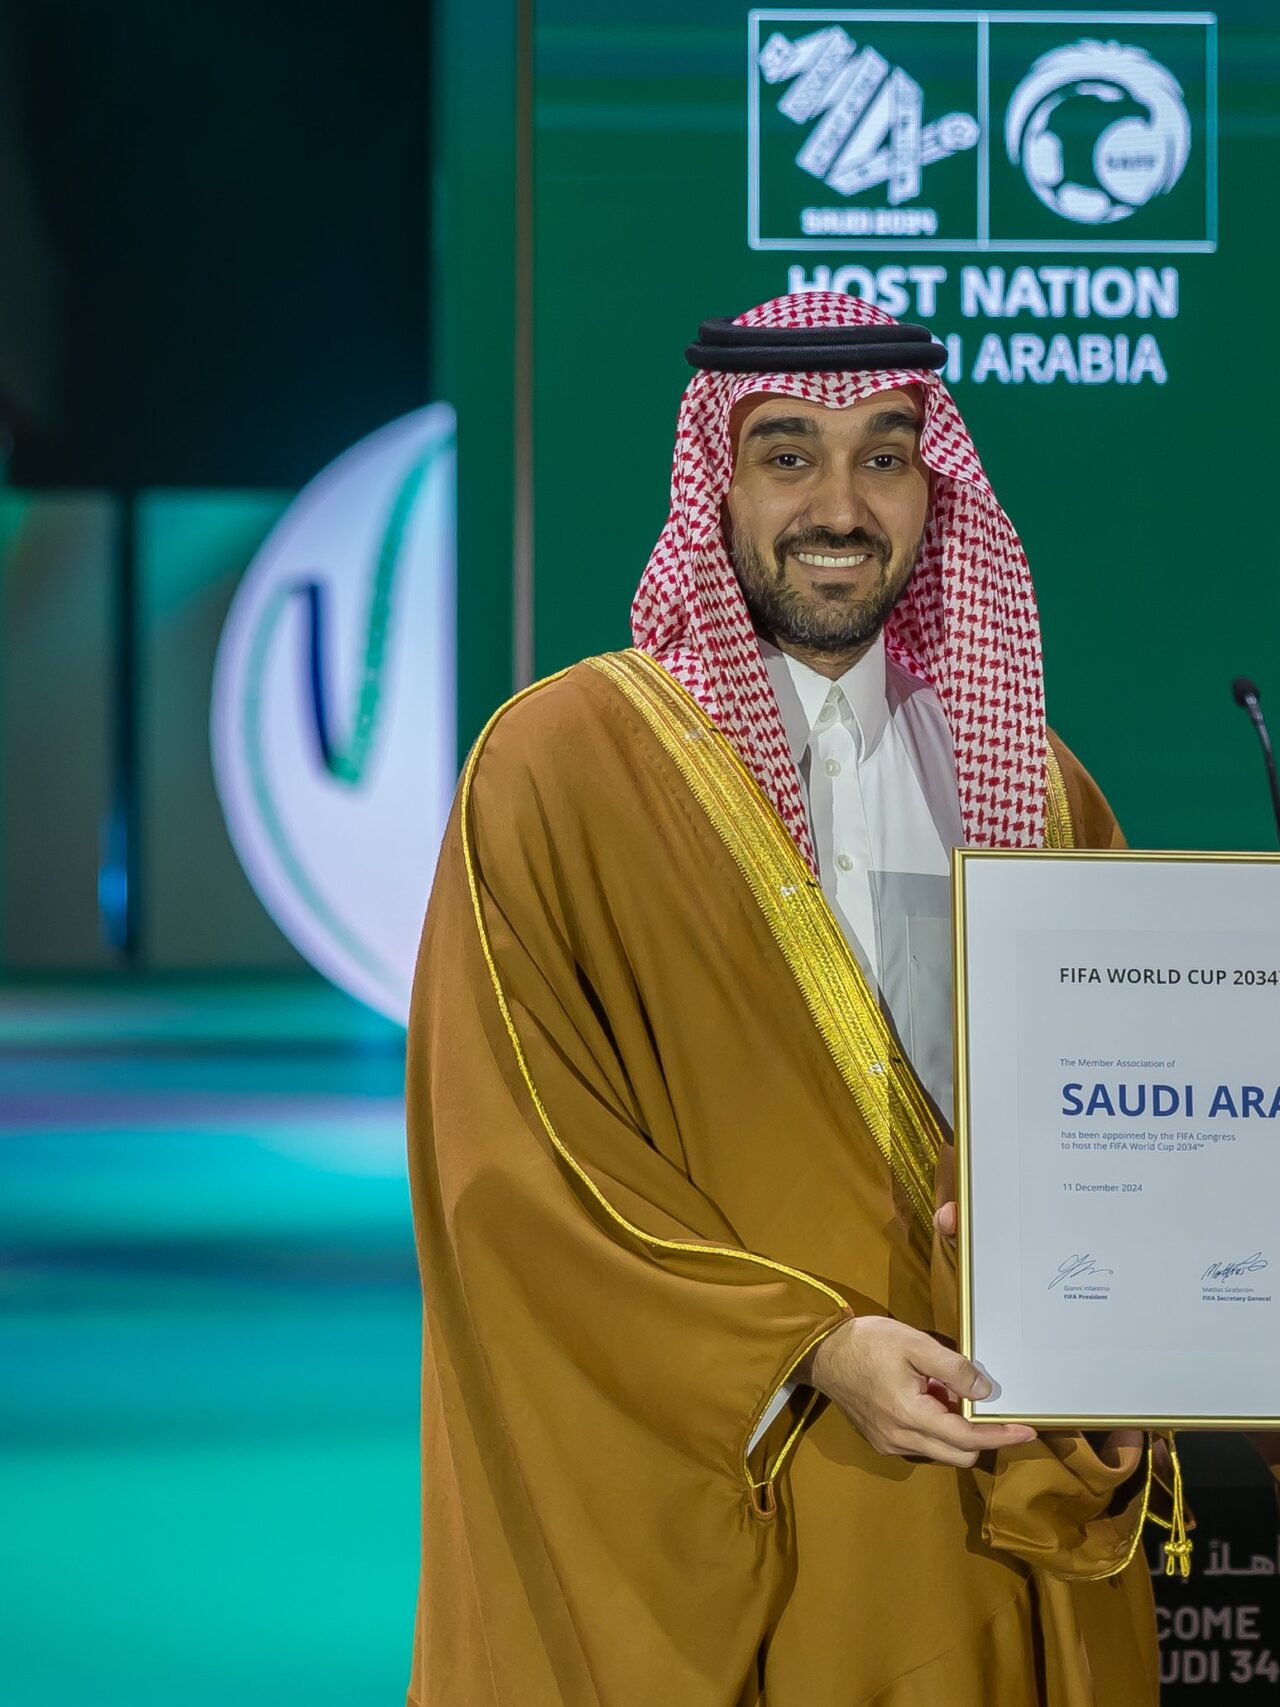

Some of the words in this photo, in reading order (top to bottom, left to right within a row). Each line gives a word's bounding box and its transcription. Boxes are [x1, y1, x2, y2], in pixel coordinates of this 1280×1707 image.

[961, 266, 1179, 318] NATION
[972, 333, 1168, 385] ARABIA
[1060, 967, 1102, 984] FIFA
[1106, 968, 1181, 985] WORLD
[1187, 969, 1227, 985] CUP
[1059, 1058, 1076, 1067] The
[1078, 1058, 1114, 1068] Member
[1116, 1059, 1165, 1068] Association
[1166, 1059, 1176, 1068] of
[1062, 1083, 1194, 1117] SAUDI
[1060, 1130, 1077, 1139] has
[1078, 1130, 1100, 1139] been
[1101, 1131, 1146, 1143] appointed
[1147, 1131, 1158, 1143] by
[1160, 1131, 1175, 1140] the
[1176, 1132, 1194, 1141] FIFA
[1196, 1132, 1236, 1143] Congress
[1061, 1142, 1071, 1150] to
[1072, 1141, 1091, 1150] host
[1093, 1141, 1109, 1150] the
[1109, 1142, 1128, 1151] FIFA
[1130, 1142, 1156, 1151] World
[1157, 1142, 1175, 1153] Cup
[1062, 1183, 1072, 1192] 11
[1075, 1183, 1119, 1192] December
[1121, 1184, 1143, 1193] 2024
[1230, 1649, 1280, 1685] 34
